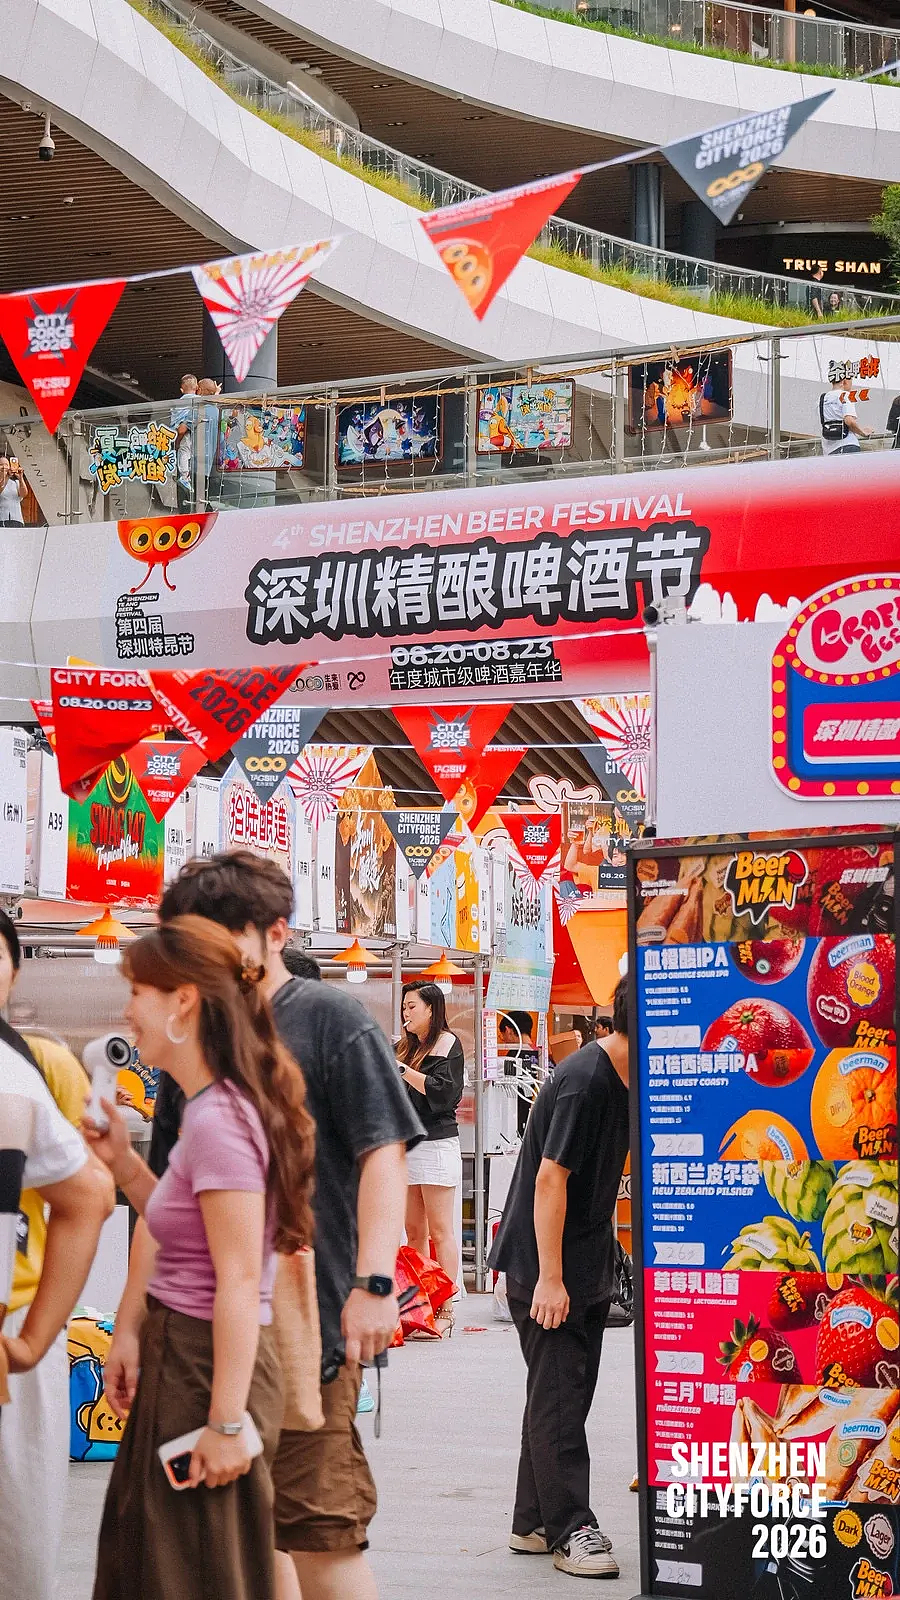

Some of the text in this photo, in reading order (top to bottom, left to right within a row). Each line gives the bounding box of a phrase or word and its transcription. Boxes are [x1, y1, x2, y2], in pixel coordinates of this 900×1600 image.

[700, 106, 792, 151] SHENZHEN
[695, 121, 786, 170] CITYFORCE
[738, 138, 784, 168] 2026
[835, 260, 881, 275] SHAN
[34, 312, 68, 328] CITY
[28, 323, 75, 341] FORCE
[30, 337, 72, 353] 2026
[272, 492, 692, 550] 4th SHENZHEN BEER FESTIVAL
[252, 530, 701, 637] 深圳精酿啤酒节
[117, 616, 163, 636] 第四届
[117, 635, 193, 657] 深圳特昂节
[392, 640, 552, 666] 08.20-08.23
[53, 670, 96, 686] CITY
[390, 661, 562, 690] 年度城市级啤酒嘉年华
[59, 696, 153, 711] 08.20-08.23
[189, 675, 251, 733] 2026
[430, 730, 471, 740] FORCE
[437, 723, 465, 732] CITY
[267, 740, 300, 755] 2026
[432, 739, 467, 748] 2026
[623, 742, 650, 750] 202
[147, 761, 180, 769] FORCE
[152, 755, 177, 763] CITY
[148, 768, 177, 776] 2026
[48, 812, 63, 831] A39
[399, 813, 440, 824] SHENZHEN
[398, 823, 440, 835] CITYFORCE
[419, 835, 440, 845] 2026
[735, 851, 792, 880] Beer
[737, 876, 795, 907] MAN
[827, 882, 854, 910] Beer
[831, 937, 872, 964] beerman
[697, 970, 715, 978] SOUR
[853, 970, 876, 986] Blood
[850, 980, 876, 997] Orange
[855, 1020, 889, 1039] Beer
[649, 1053, 759, 1075] 双倍西海岸IPA
[842, 1055, 885, 1071] beerman
[649, 1078, 729, 1087] DIPA (WEST COAST)
[830, 1101, 848, 1117] DIPA
[858, 1126, 889, 1143] Beer
[769, 1130, 792, 1160] beerm
[860, 1140, 893, 1158] MAN
[652, 1162, 760, 1185] 新西兰皮尔森
[652, 1187, 753, 1196] NEW ZEALAND PILSNER
[869, 1207, 894, 1223] Zealand
[874, 1200, 888, 1212] New
[654, 1271, 740, 1295] 草莓乳酸菌
[785, 1277, 803, 1304] Beer
[842, 1421, 881, 1435] beerman
[870, 1458, 900, 1481] Beer
[864, 1474, 900, 1501] MAN
[838, 1519, 859, 1538] Dark
[870, 1523, 891, 1546] Lager
[857, 1559, 887, 1590] Beer
